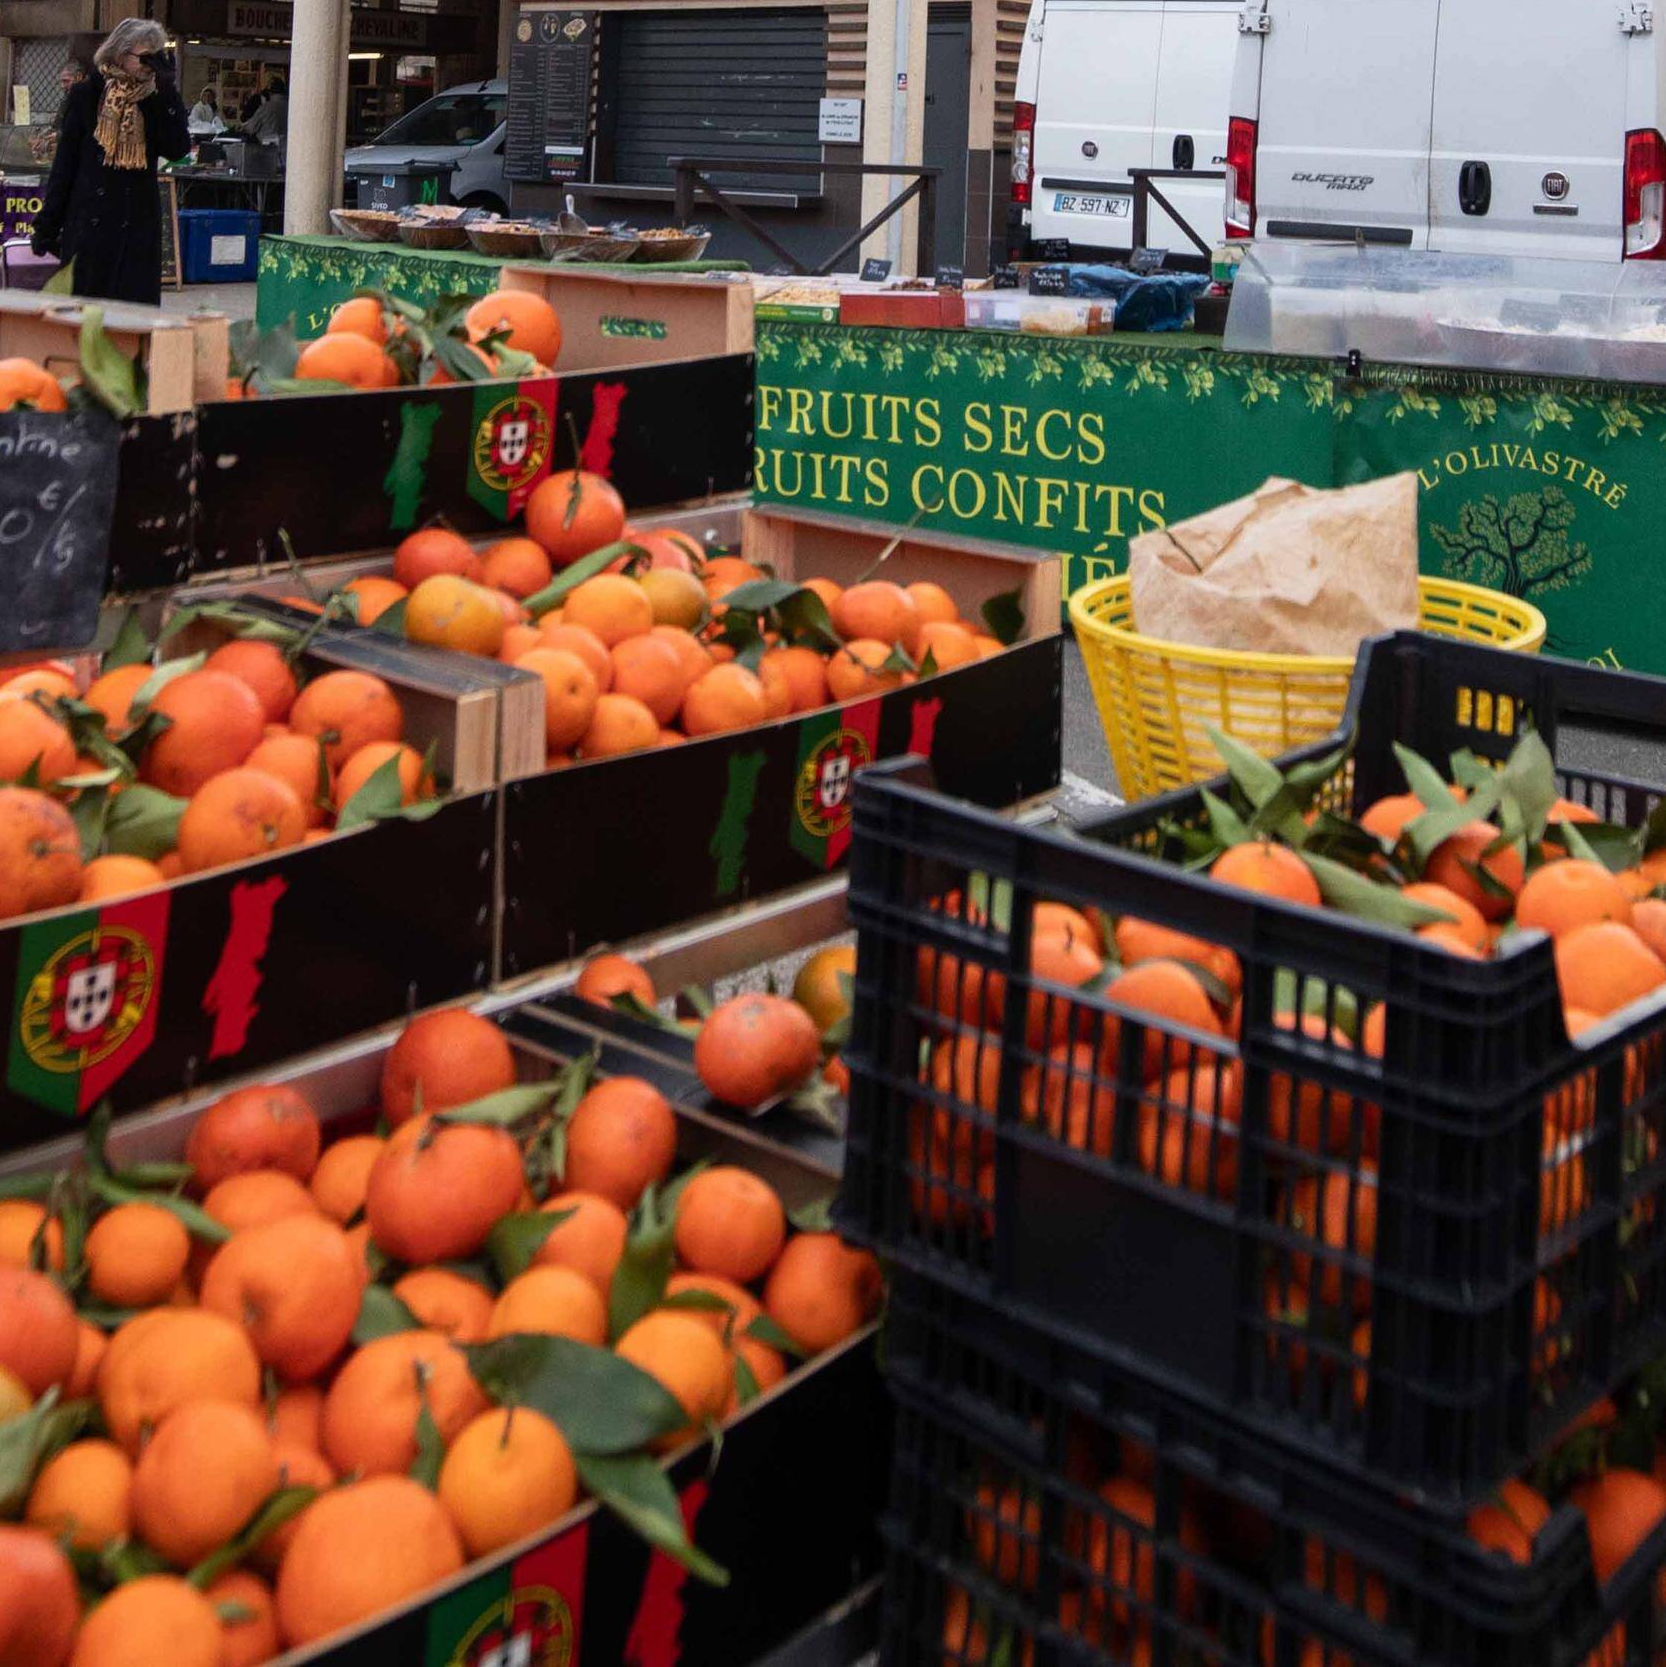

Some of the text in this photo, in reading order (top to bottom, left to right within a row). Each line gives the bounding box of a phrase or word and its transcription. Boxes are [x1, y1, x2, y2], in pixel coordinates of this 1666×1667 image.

[351, 15, 420, 39] HEVALINE
[758, 385, 1105, 465] FRUITS SECS
[911, 464, 1167, 537] CONFITS
[1417, 443, 1628, 510] L'OLIVASTRÉ
